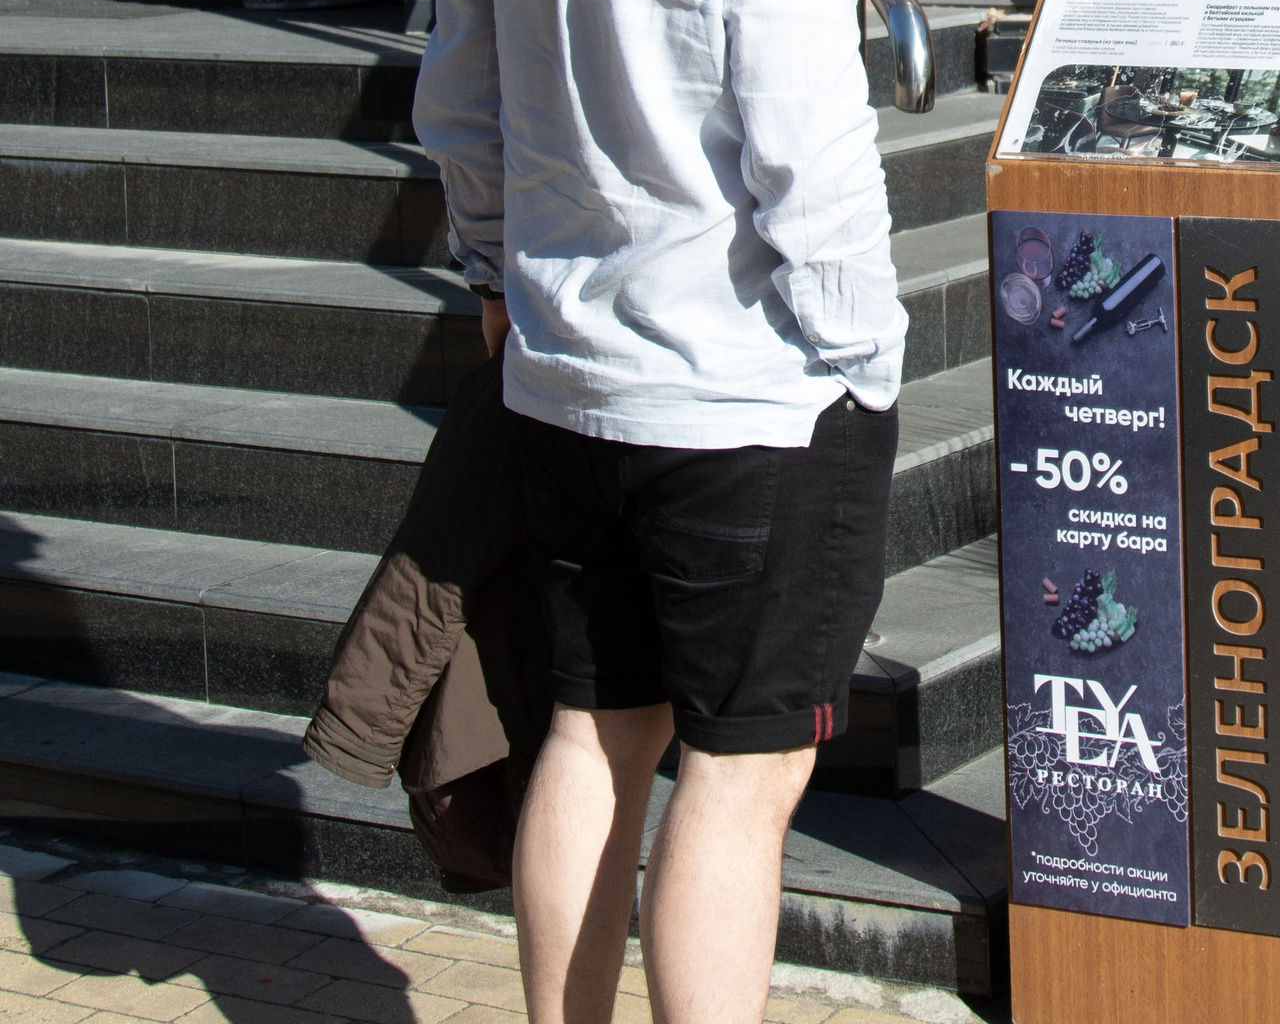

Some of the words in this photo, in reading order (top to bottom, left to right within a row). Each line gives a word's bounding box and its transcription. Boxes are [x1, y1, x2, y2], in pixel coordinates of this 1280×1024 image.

[1008, 369, 1102, 396] Каждый
[1065, 406, 1165, 431] четверг!
[1069, 509, 1136, 528] скидка
[1142, 516, 1166, 529] на
[1057, 530, 1112, 549] карту
[1117, 533, 1166, 553] бара
[1205, 266, 1275, 890] ЗЕЛЕНОГРАДСК
[1038, 769, 1162, 798] РЕСТОРАН
[1023, 871, 1088, 890] уточняйте
[1091, 880, 1100, 894] у
[1102, 880, 1177, 902] официанта
[1127, 868, 1168, 882] акции
